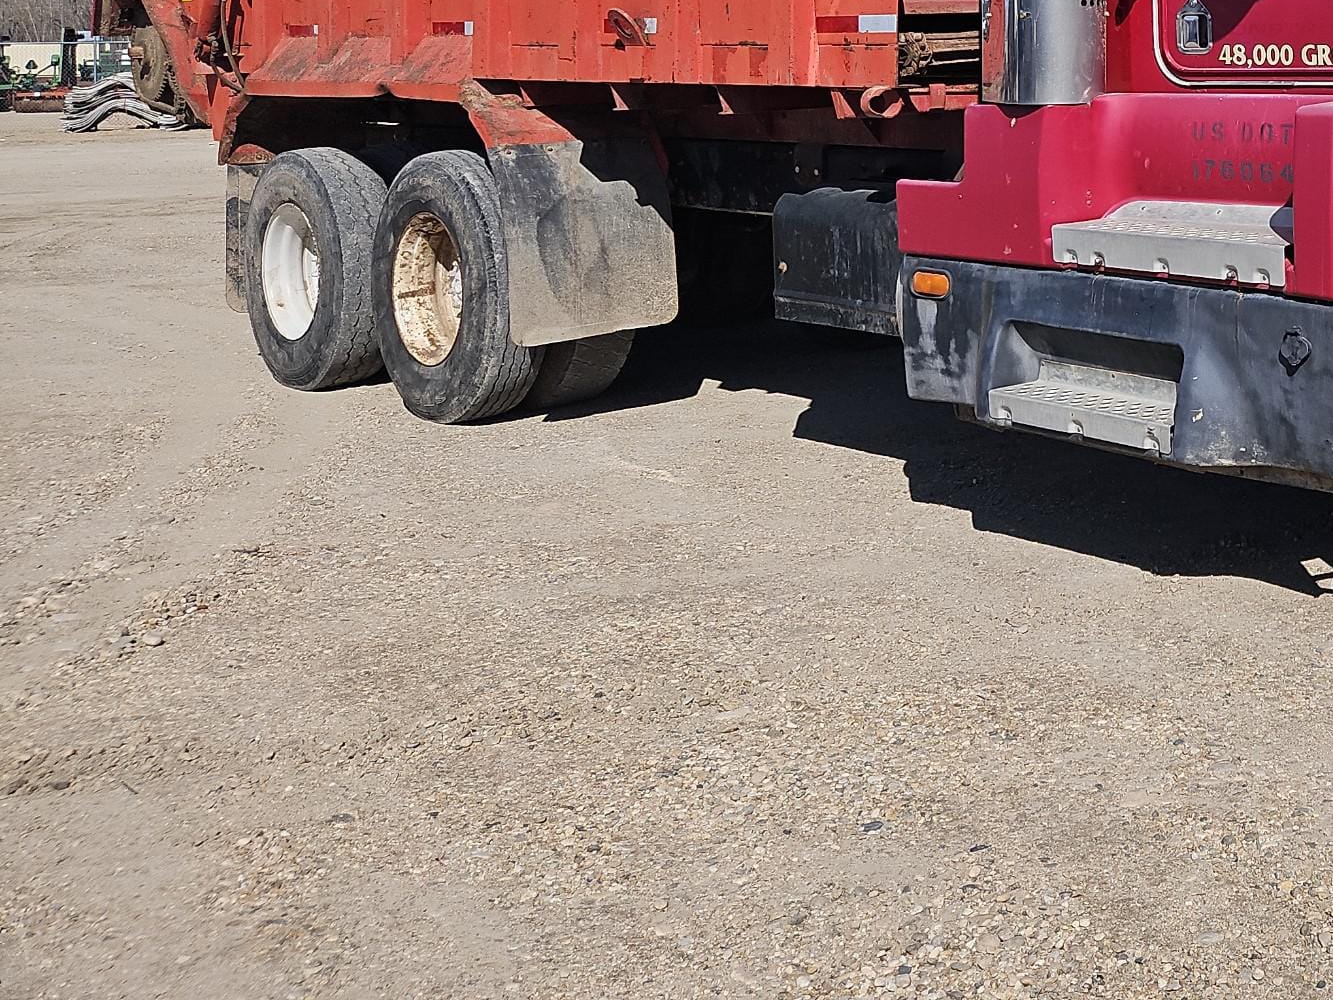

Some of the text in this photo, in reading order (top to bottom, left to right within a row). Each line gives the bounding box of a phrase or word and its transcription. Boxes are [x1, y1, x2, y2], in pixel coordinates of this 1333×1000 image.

[1218, 44, 1294, 68] 48,000
[1191, 120, 1294, 145] US DOT
